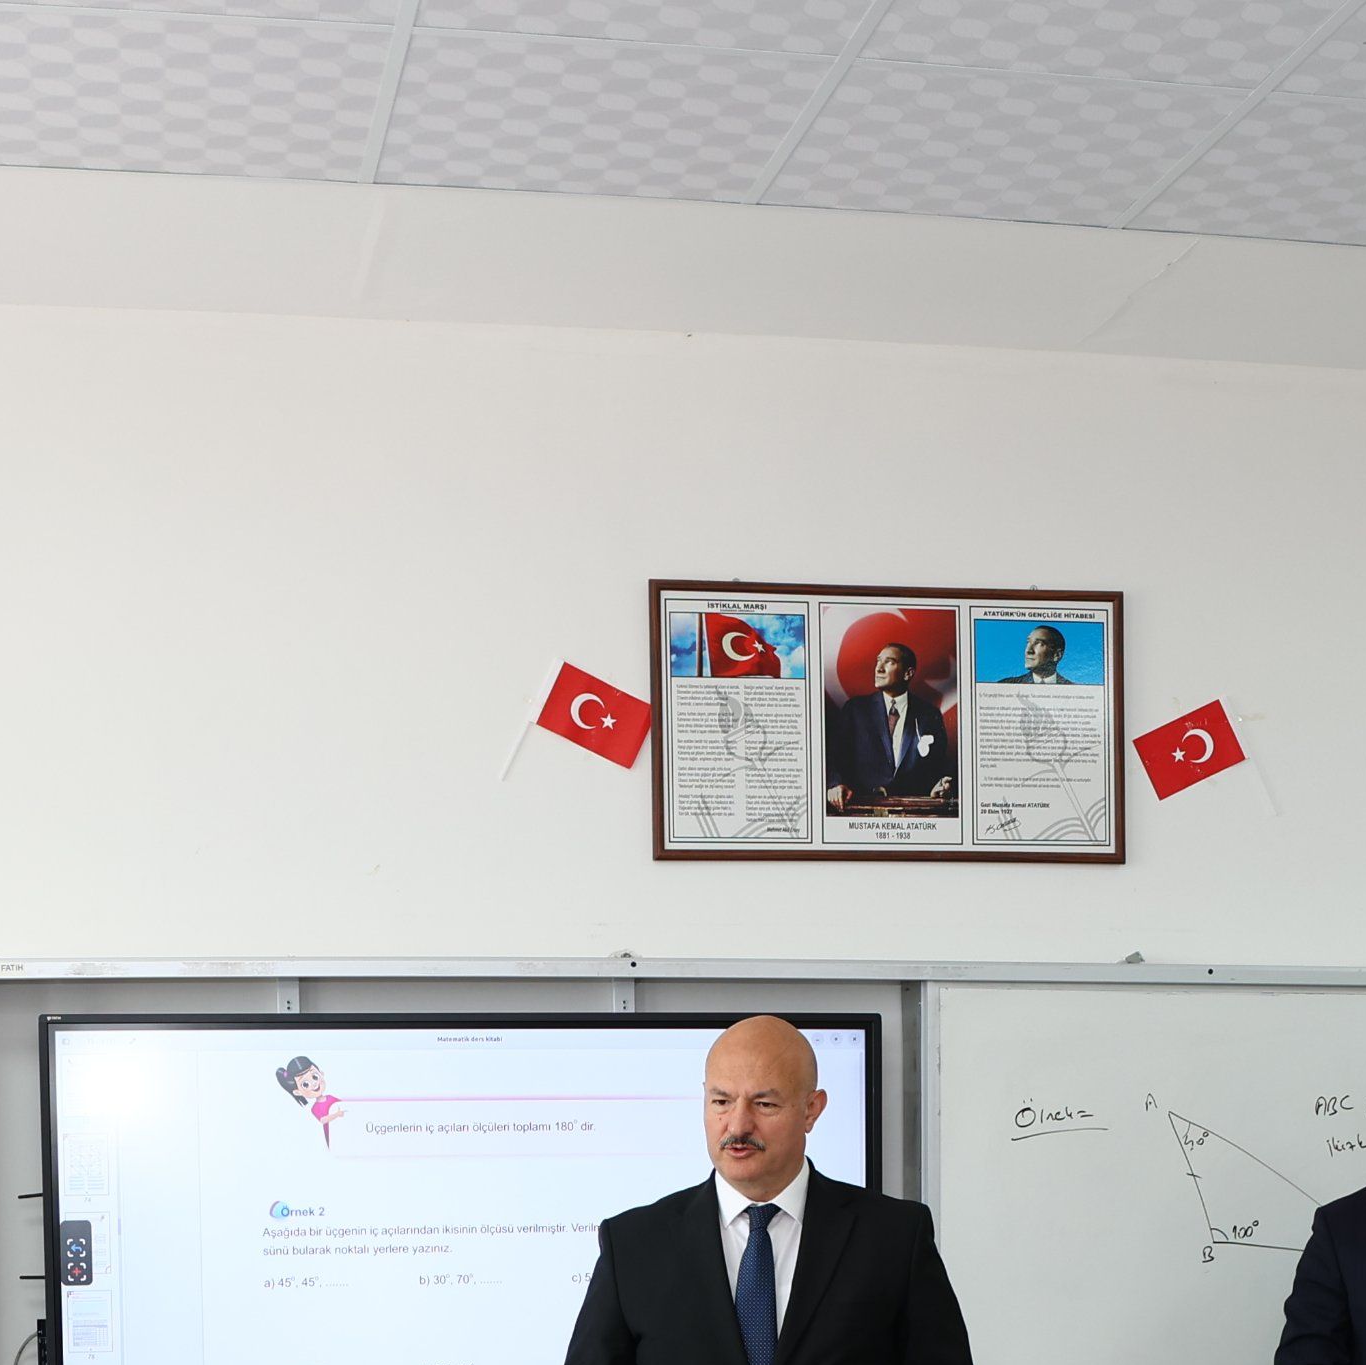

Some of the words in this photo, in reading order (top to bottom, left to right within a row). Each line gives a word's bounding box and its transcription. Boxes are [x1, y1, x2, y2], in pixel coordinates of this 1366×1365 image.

[707, 602, 741, 610] İSTİKLAL
[1028, 611, 1062, 619] GENÇLİĞE
[1064, 611, 1095, 619] HİTABESİ
[848, 822, 880, 830] MUSTAFA
[882, 822, 905, 830] KEMAL
[907, 821, 937, 830] ATATÜRK
[896, 832, 911, 840] 1938
[1145, 1093, 1158, 1112] A
[1315, 1095, 1354, 1116] ABC
[365, 1122, 423, 1135] Üçgenlerin
[425, 1123, 435, 1135] iç
[437, 1122, 470, 1135] açıları
[472, 1122, 510, 1134] ölçüleri
[513, 1121, 551, 1134] toplamı
[580, 1121, 596, 1132] dir.
[281, 1204, 315, 1218] Örnek
[318, 1207, 325, 1216] 2
[262, 1226, 307, 1239] Aşağıda
[309, 1226, 322, 1237] bir
[325, 1226, 367, 1238] üçgenin
[370, 1226, 378, 1237] iç
[381, 1225, 440, 1237] açılarından
[442, 1224, 478, 1234] ikisinin
[480, 1224, 514, 1236] ölçüsü
[516, 1223, 568, 1235] verilmiştir.
[263, 1245, 289, 1256] sünü
[292, 1245, 331, 1255] bularak
[335, 1244, 369, 1255] noktalı
[373, 1244, 409, 1256] yerlere
[412, 1244, 453, 1256] yazınız.
[1202, 1246, 1215, 1263] B
[264, 1278, 275, 1289] a)
[419, 1275, 430, 1286] b)
[571, 1273, 582, 1284] c)
